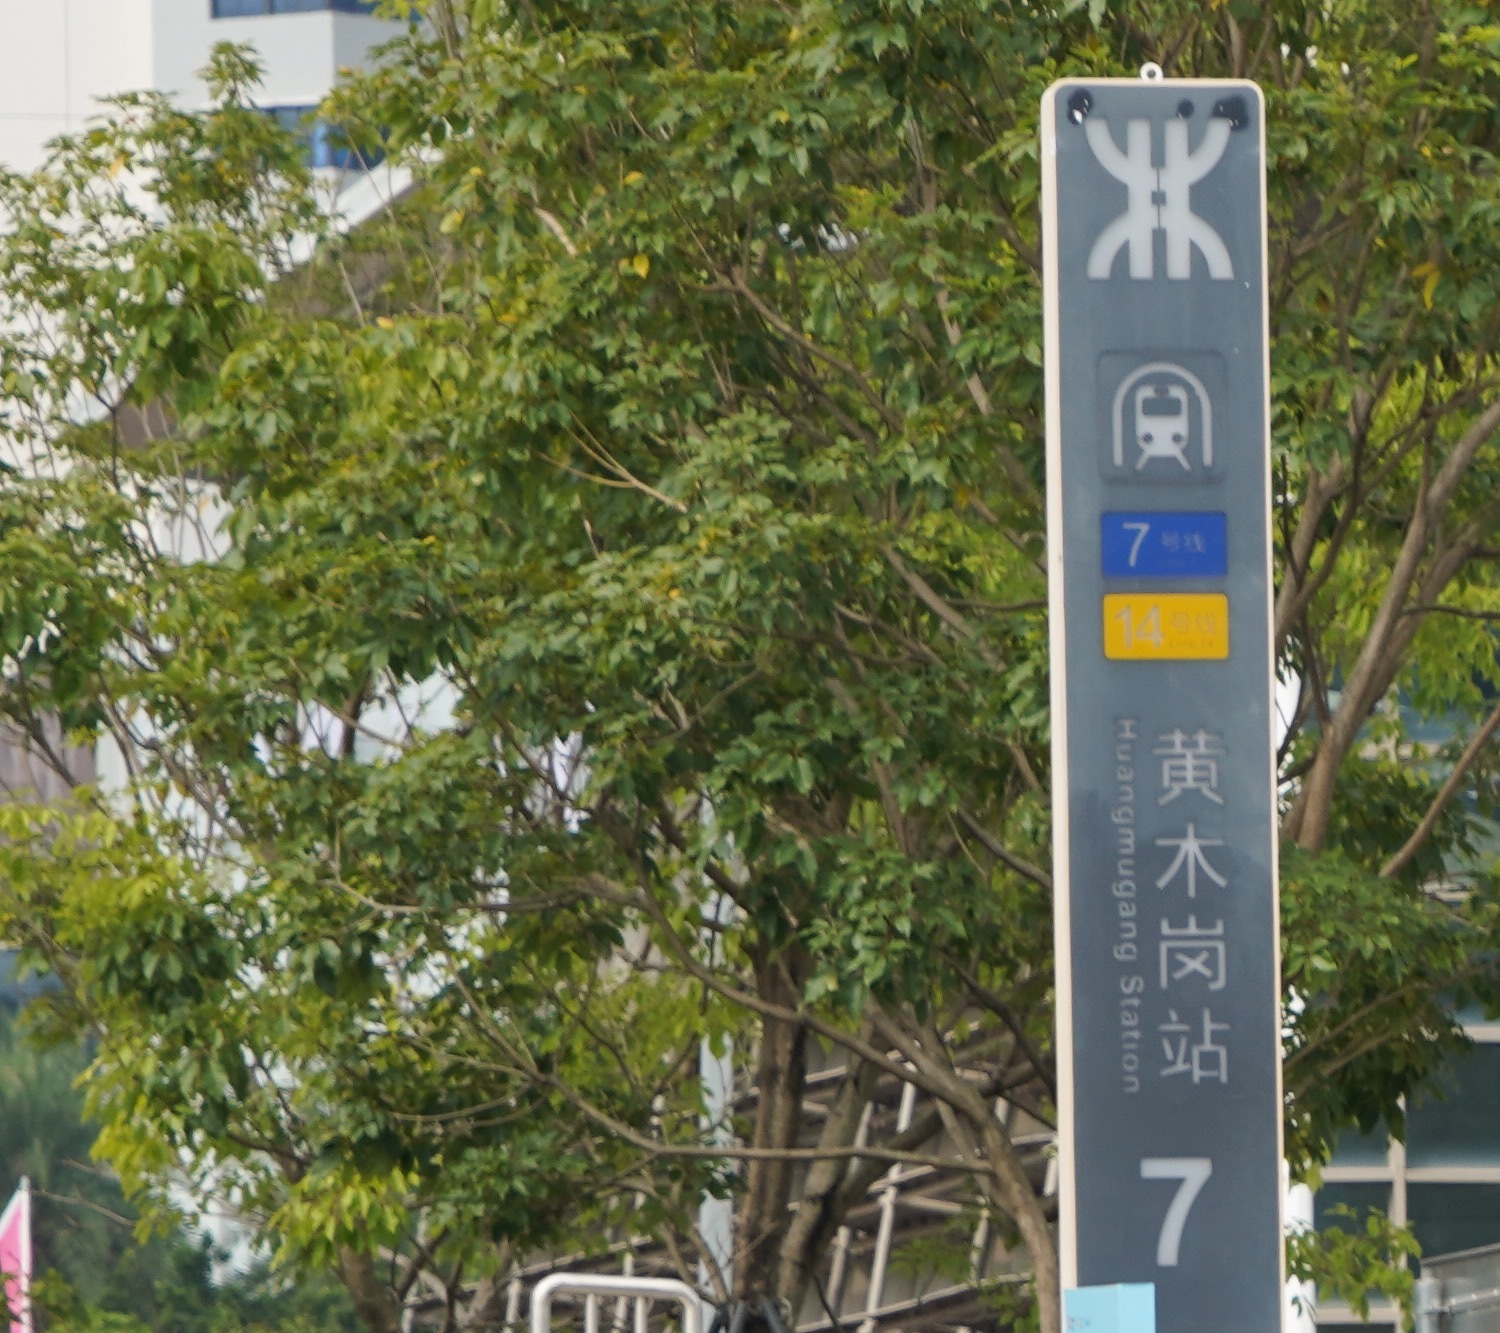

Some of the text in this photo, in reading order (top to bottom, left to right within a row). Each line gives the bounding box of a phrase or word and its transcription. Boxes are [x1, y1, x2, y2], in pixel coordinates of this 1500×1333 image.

[1122, 522, 1150, 567] 7
[1115, 604, 1164, 648] 14
[1111, 718, 1144, 1093] Huangmugang Station
[1152, 729, 1230, 1083] 黄木岗站
[1140, 1158, 1212, 1266] 7
